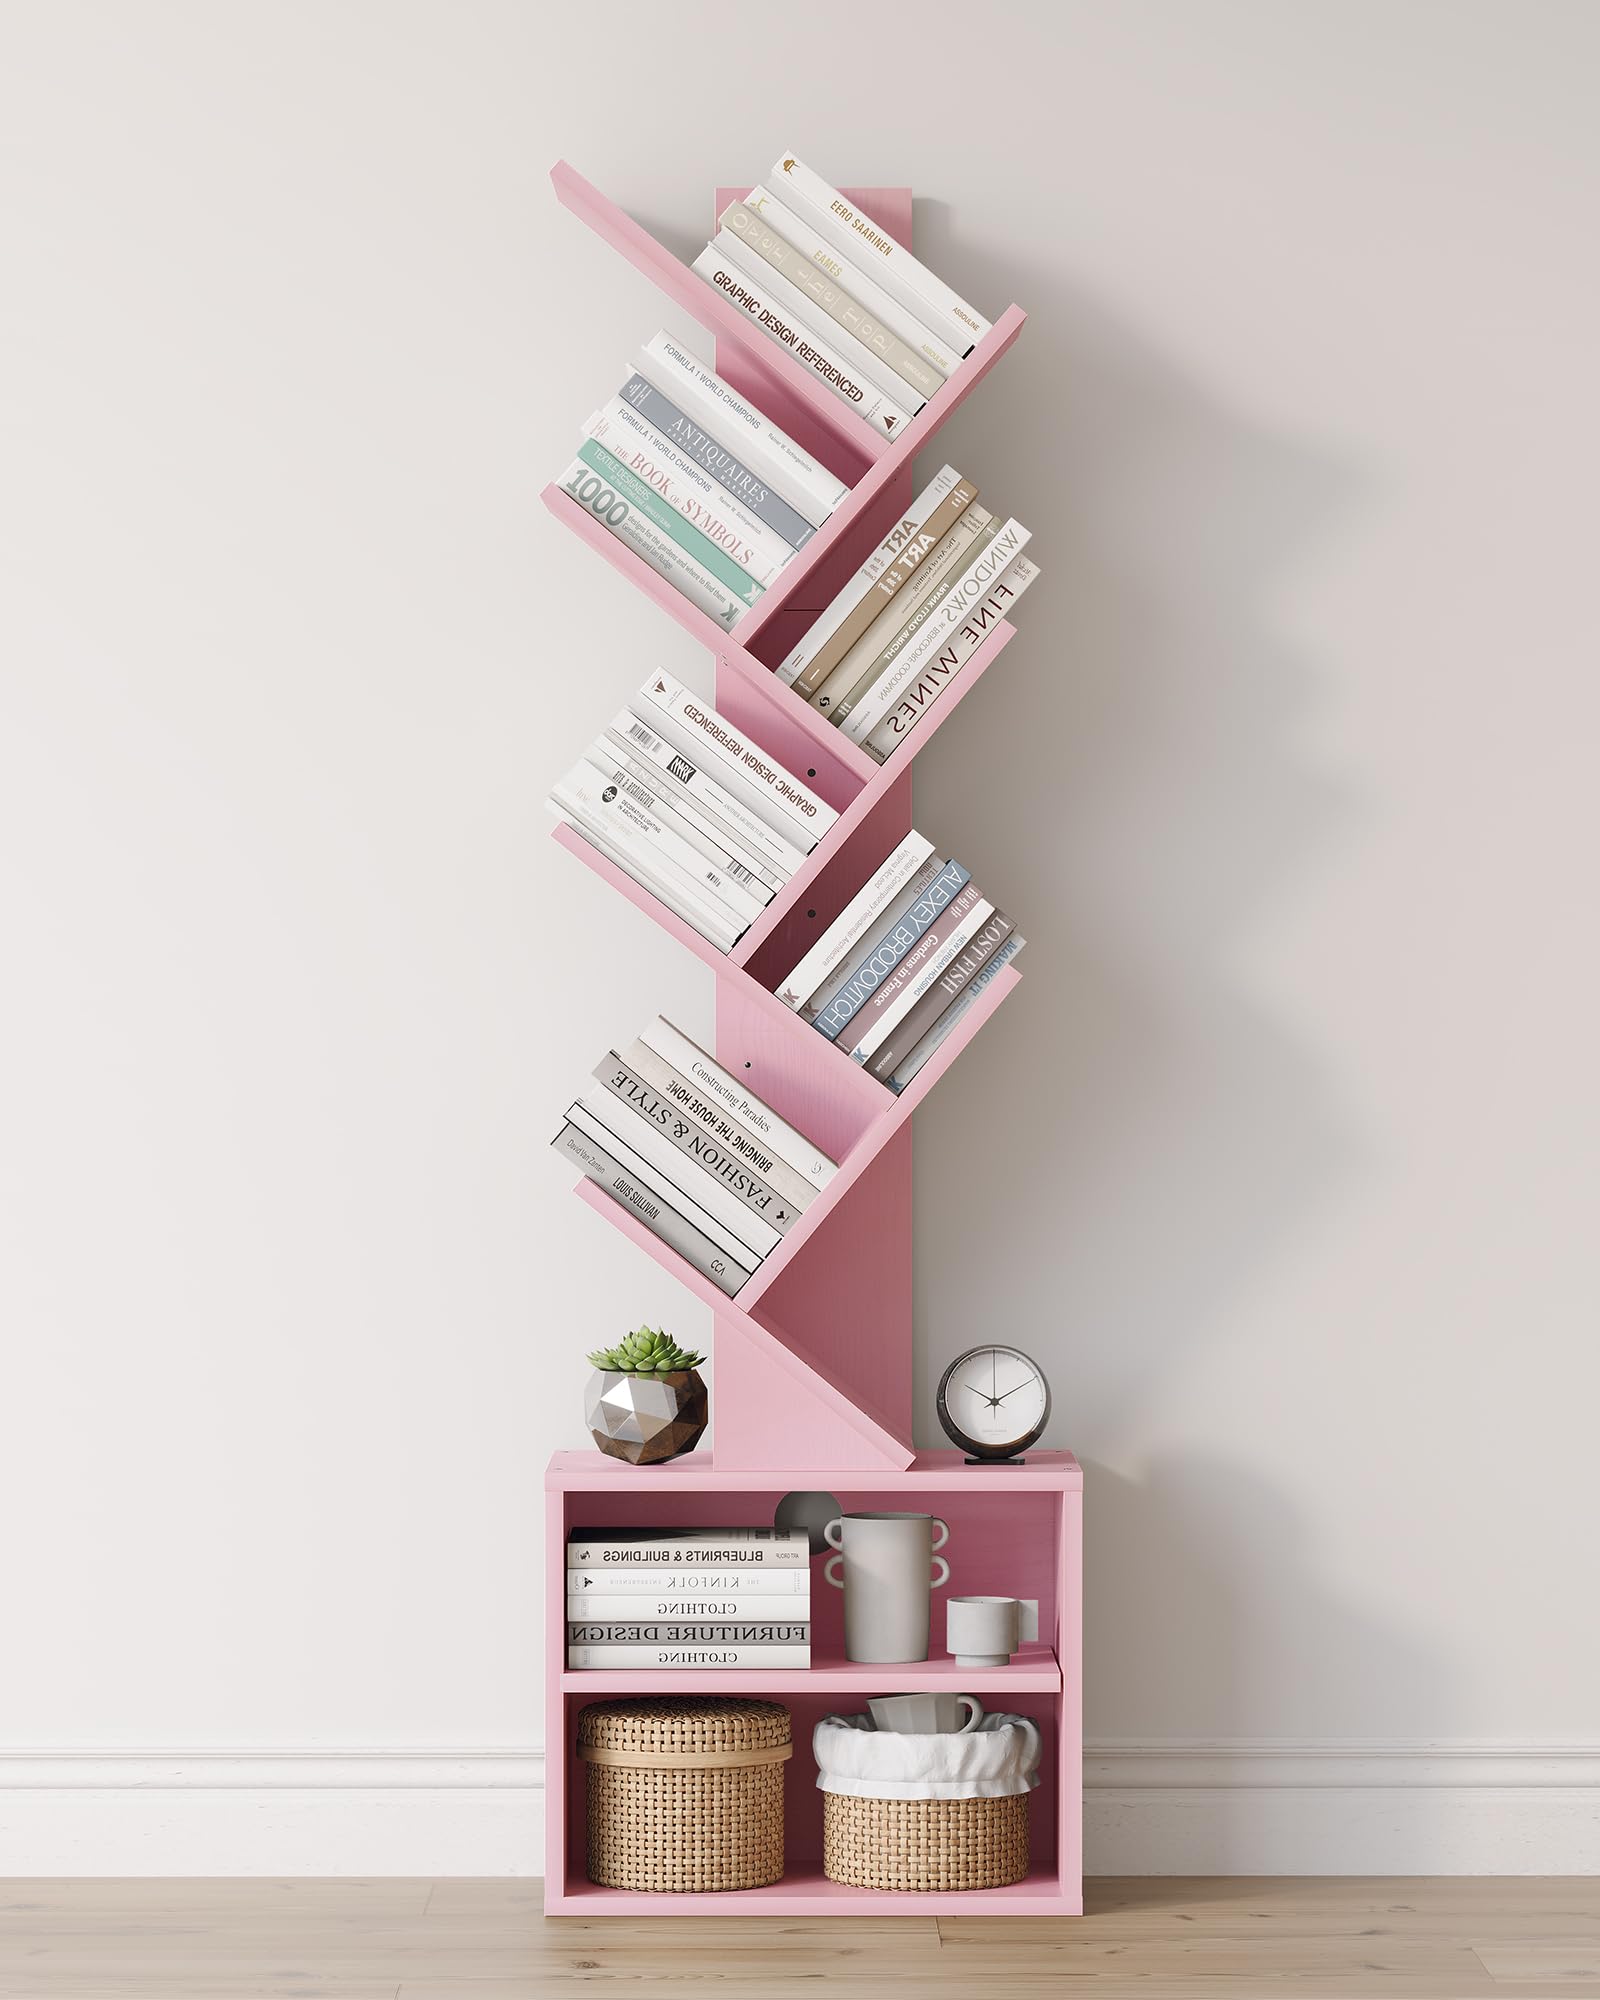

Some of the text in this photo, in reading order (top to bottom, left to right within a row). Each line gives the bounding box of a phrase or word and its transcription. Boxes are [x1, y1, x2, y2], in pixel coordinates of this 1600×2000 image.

[829, 199, 893, 255] EERO SAARINEN
[812, 249, 843, 278] EAMES
[711, 269, 762, 315] GRAPHIC
[758, 309, 798, 346] DESIGN
[796, 342, 863, 402] REFERENCED
[951, 306, 981, 332] ASSOULINE
[919, 343, 949, 369] ASSOULINE
[662, 342, 760, 429] FORMULA 1 WORLD CHAMPIONS
[616, 408, 650, 438] FORMULA
[647, 434, 654, 442] 1
[651, 437, 677, 462] WORLD
[673, 457, 713, 493] CHAMPIONS
[668, 418, 772, 502] ANTIQUAIRES
[594, 447, 651, 500] TEXTILE DESIGNERS
[567, 470, 628, 530] 1000
[613, 444, 629, 461] THE
[629, 453, 673, 495] BOOK
[669, 493, 681, 505] OF
[681, 499, 753, 564] SYMBOLS
[626, 514, 647, 534] designs
[643, 528, 654, 539] for
[650, 535, 661, 546] the
[657, 542, 679, 562] gardens
[675, 557, 688, 569] and
[684, 564, 701, 581] where
[703, 580, 716, 593] find
[712, 588, 727, 603] them
[640, 540, 653, 552] and
[684, 704, 743, 756] REFERENCED
[668, 756, 695, 783] MARK
[741, 752, 777, 784] DESIGN
[620, 799, 646, 821] DECORATIVE
[642, 817, 662, 834] LIGHTING
[622, 808, 649, 831] ARCHITECTURE
[775, 780, 816, 817] GRAPHIC
[873, 847, 910, 890] Virginia McLeod
[902, 854, 919, 873] Detail
[867, 874, 902, 911] Contemporary
[906, 864, 964, 933] ALEXEY
[847, 909, 873, 938] Residential
[952, 933, 968, 951] NEW
[970, 915, 1010, 960] LOST
[821, 935, 850, 967] Architecture
[873, 933, 939, 1008] Gardens in France
[934, 947, 956, 971] URBAN
[966, 938, 1016, 997] MAKING IT
[824, 926, 914, 1028] BRODOVITCH
[912, 967, 939, 997] HOUSING
[940, 955, 976, 994] FISH
[692, 1062, 772, 1133] Constructing Paradies
[611, 1071, 772, 1209] FASHION & STYLE
[665, 1079, 773, 1173] BRINGING THE HOUSE HOME
[566, 1138, 606, 1175] David Van Zanten
[612, 1176, 660, 1219] LOUIS SULLIVAN
